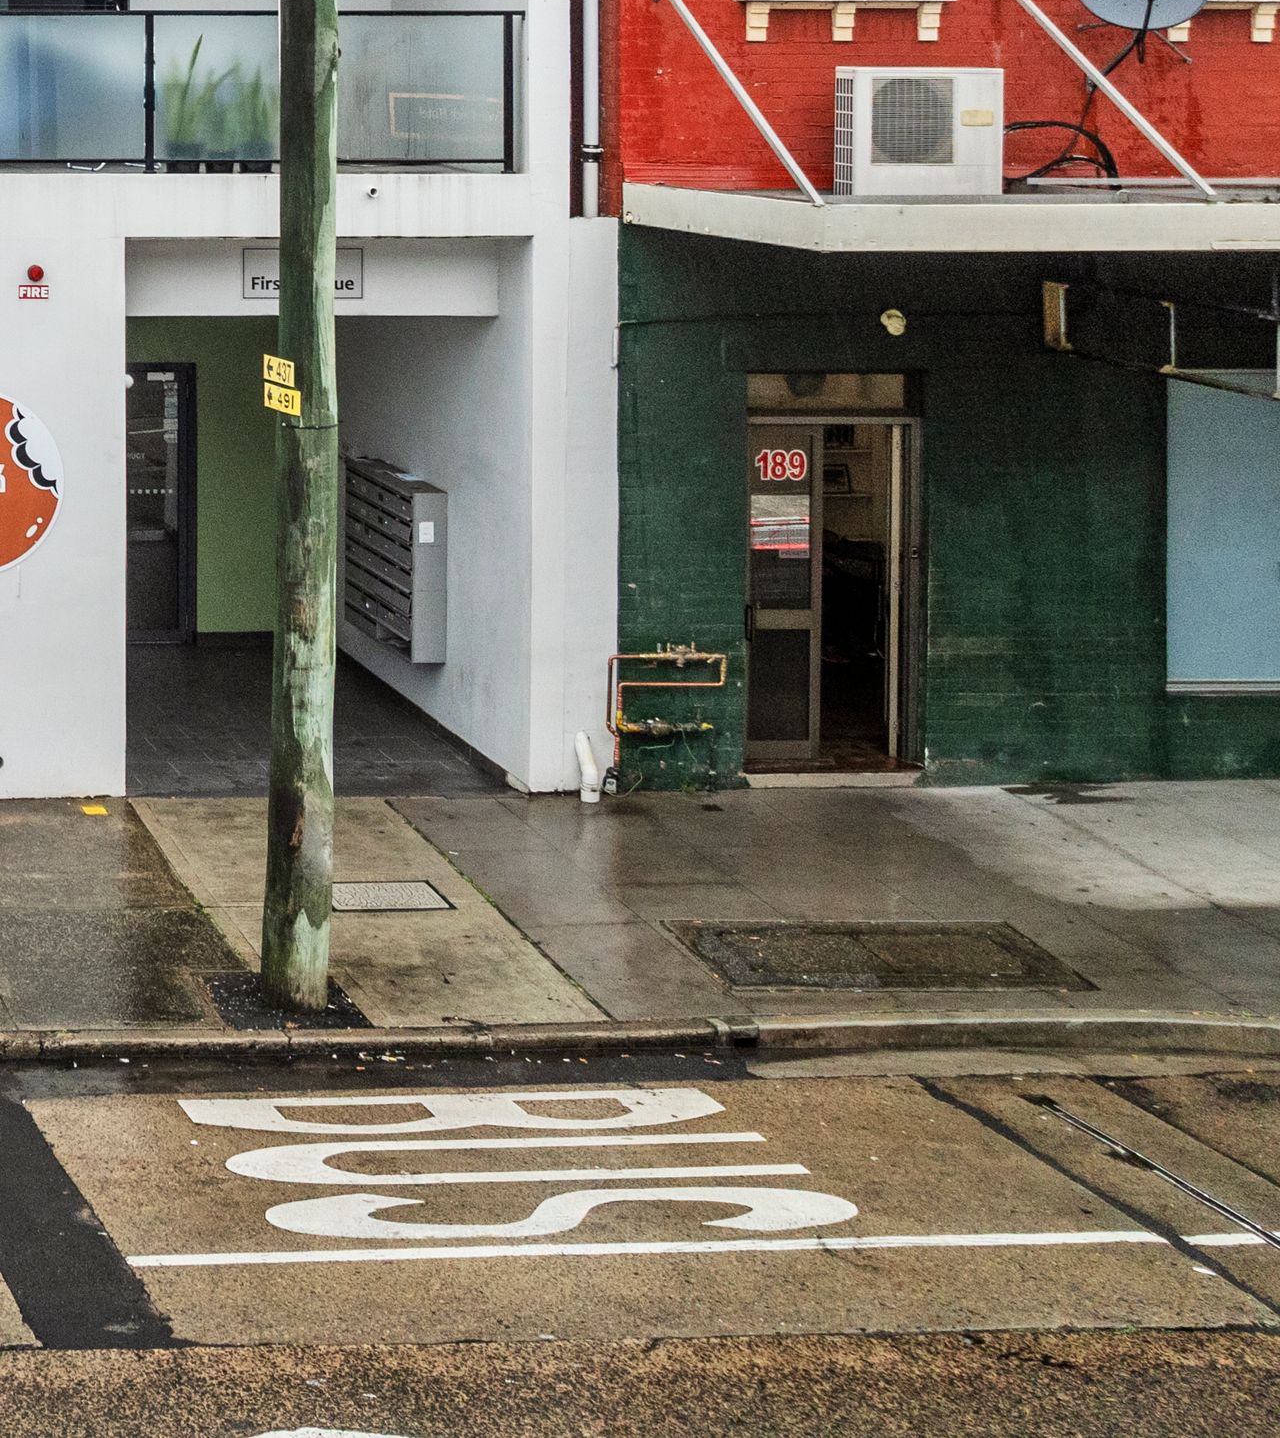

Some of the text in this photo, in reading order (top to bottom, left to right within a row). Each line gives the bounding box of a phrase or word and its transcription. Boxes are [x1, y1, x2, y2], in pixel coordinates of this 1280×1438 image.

[19, 286, 49, 298] FIRE
[251, 276, 280, 291] Firs
[276, 361, 292, 383] 437
[278, 393, 295, 410] 491
[755, 449, 807, 480] 189
[177, 1088, 858, 1239] BUS
